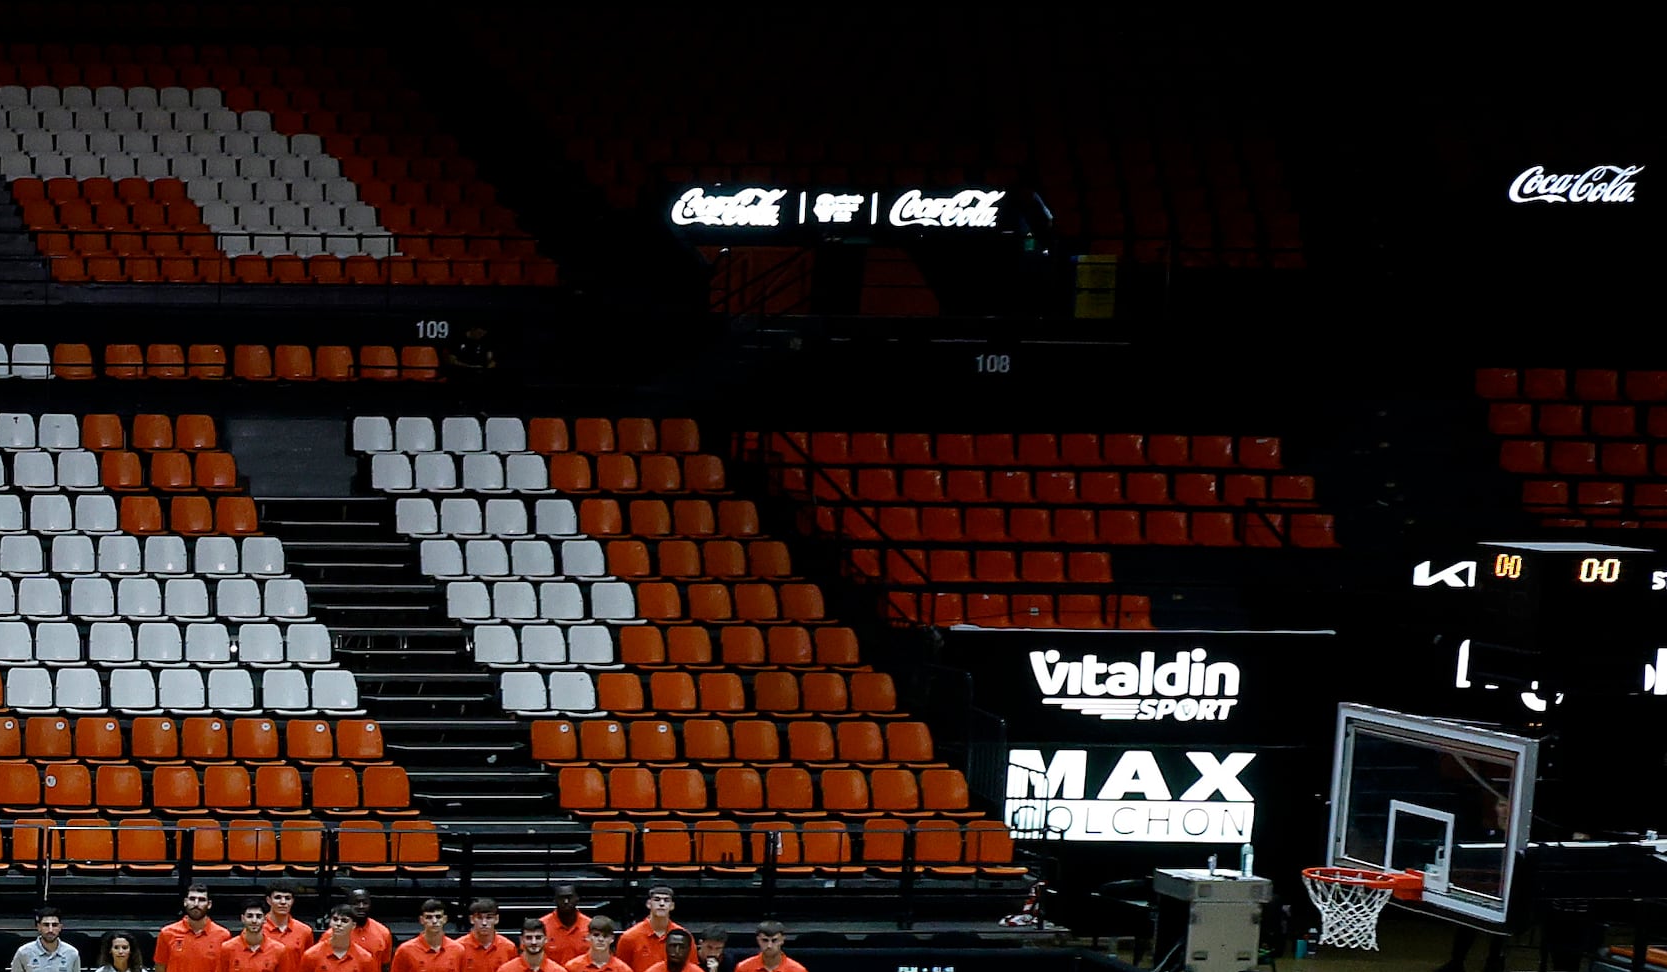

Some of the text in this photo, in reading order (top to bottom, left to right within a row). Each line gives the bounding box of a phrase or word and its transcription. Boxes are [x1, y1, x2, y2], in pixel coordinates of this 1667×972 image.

[1509, 165, 1645, 203] Coca-Cola
[417, 321, 448, 338] 109
[977, 355, 1009, 372] 108
[1029, 648, 1240, 697] Vitaldin
[1006, 749, 1257, 801] MAX
